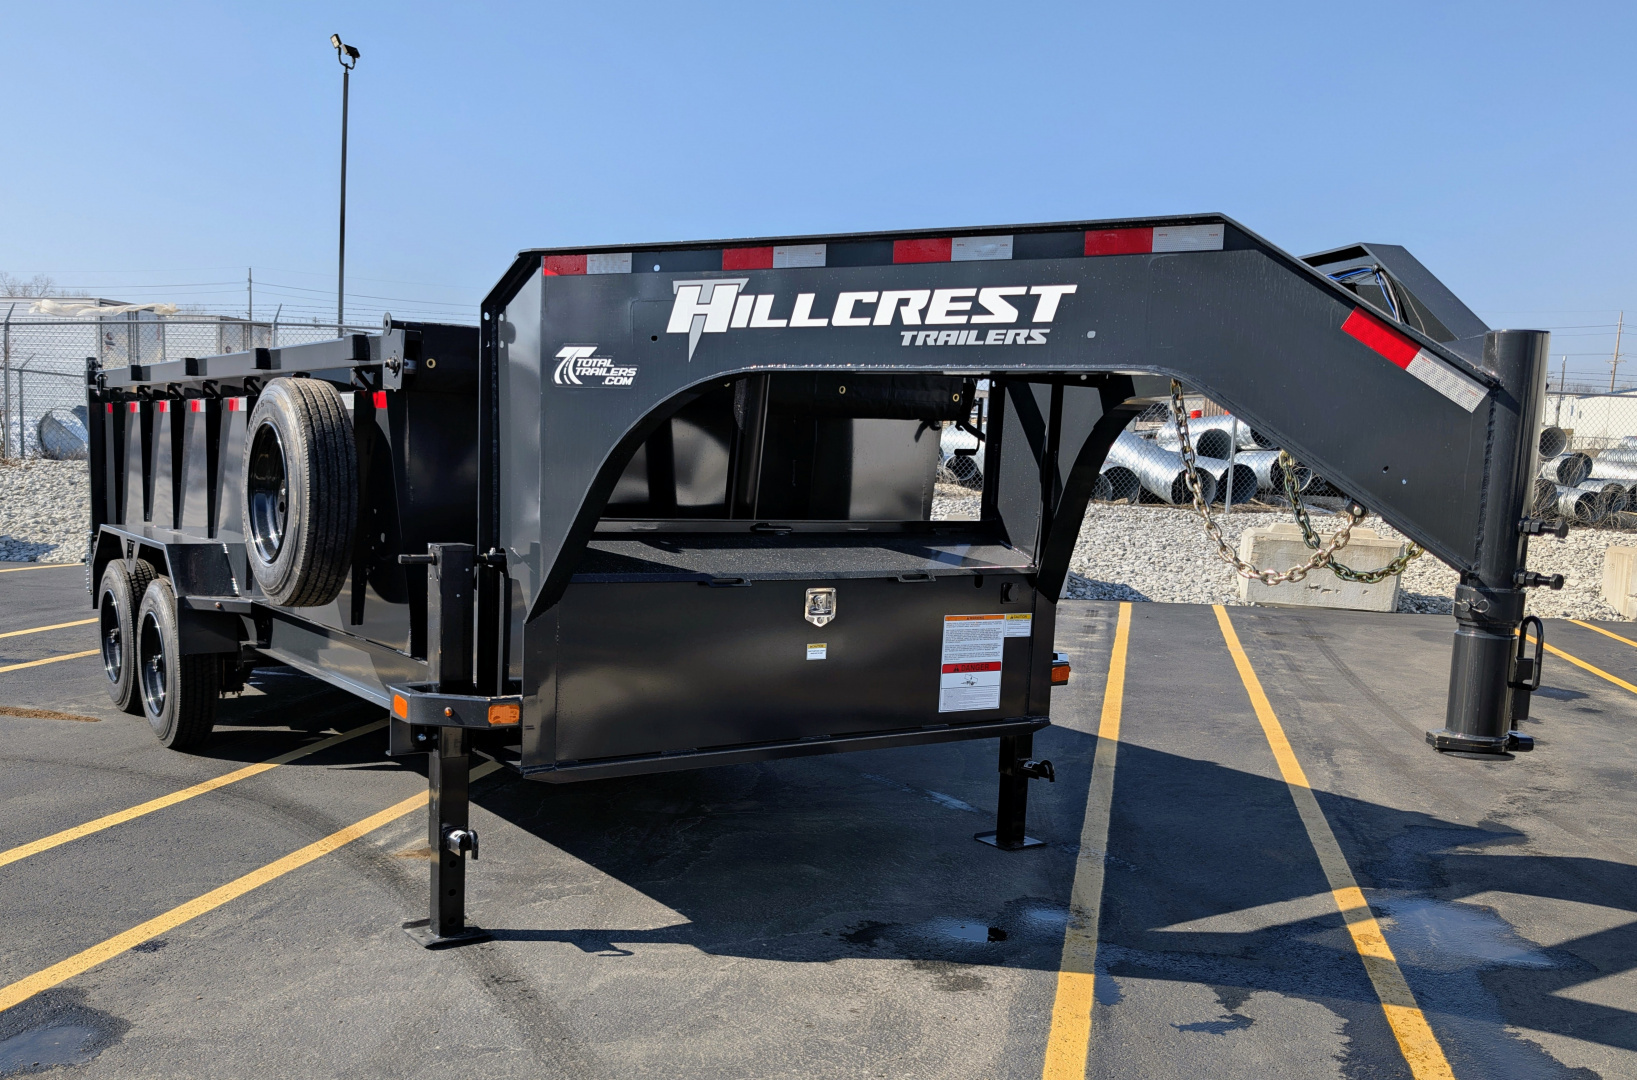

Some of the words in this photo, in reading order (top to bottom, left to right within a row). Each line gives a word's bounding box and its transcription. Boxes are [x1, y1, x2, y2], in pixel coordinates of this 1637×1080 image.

[666, 278, 1077, 333] HILLCREST
[900, 328, 1051, 346] TRAILERS
[576, 359, 614, 367] TOTAL
[575, 367, 637, 376] TRAILERS
[602, 377, 633, 385] .COM
[961, 663, 989, 672] DANGER
